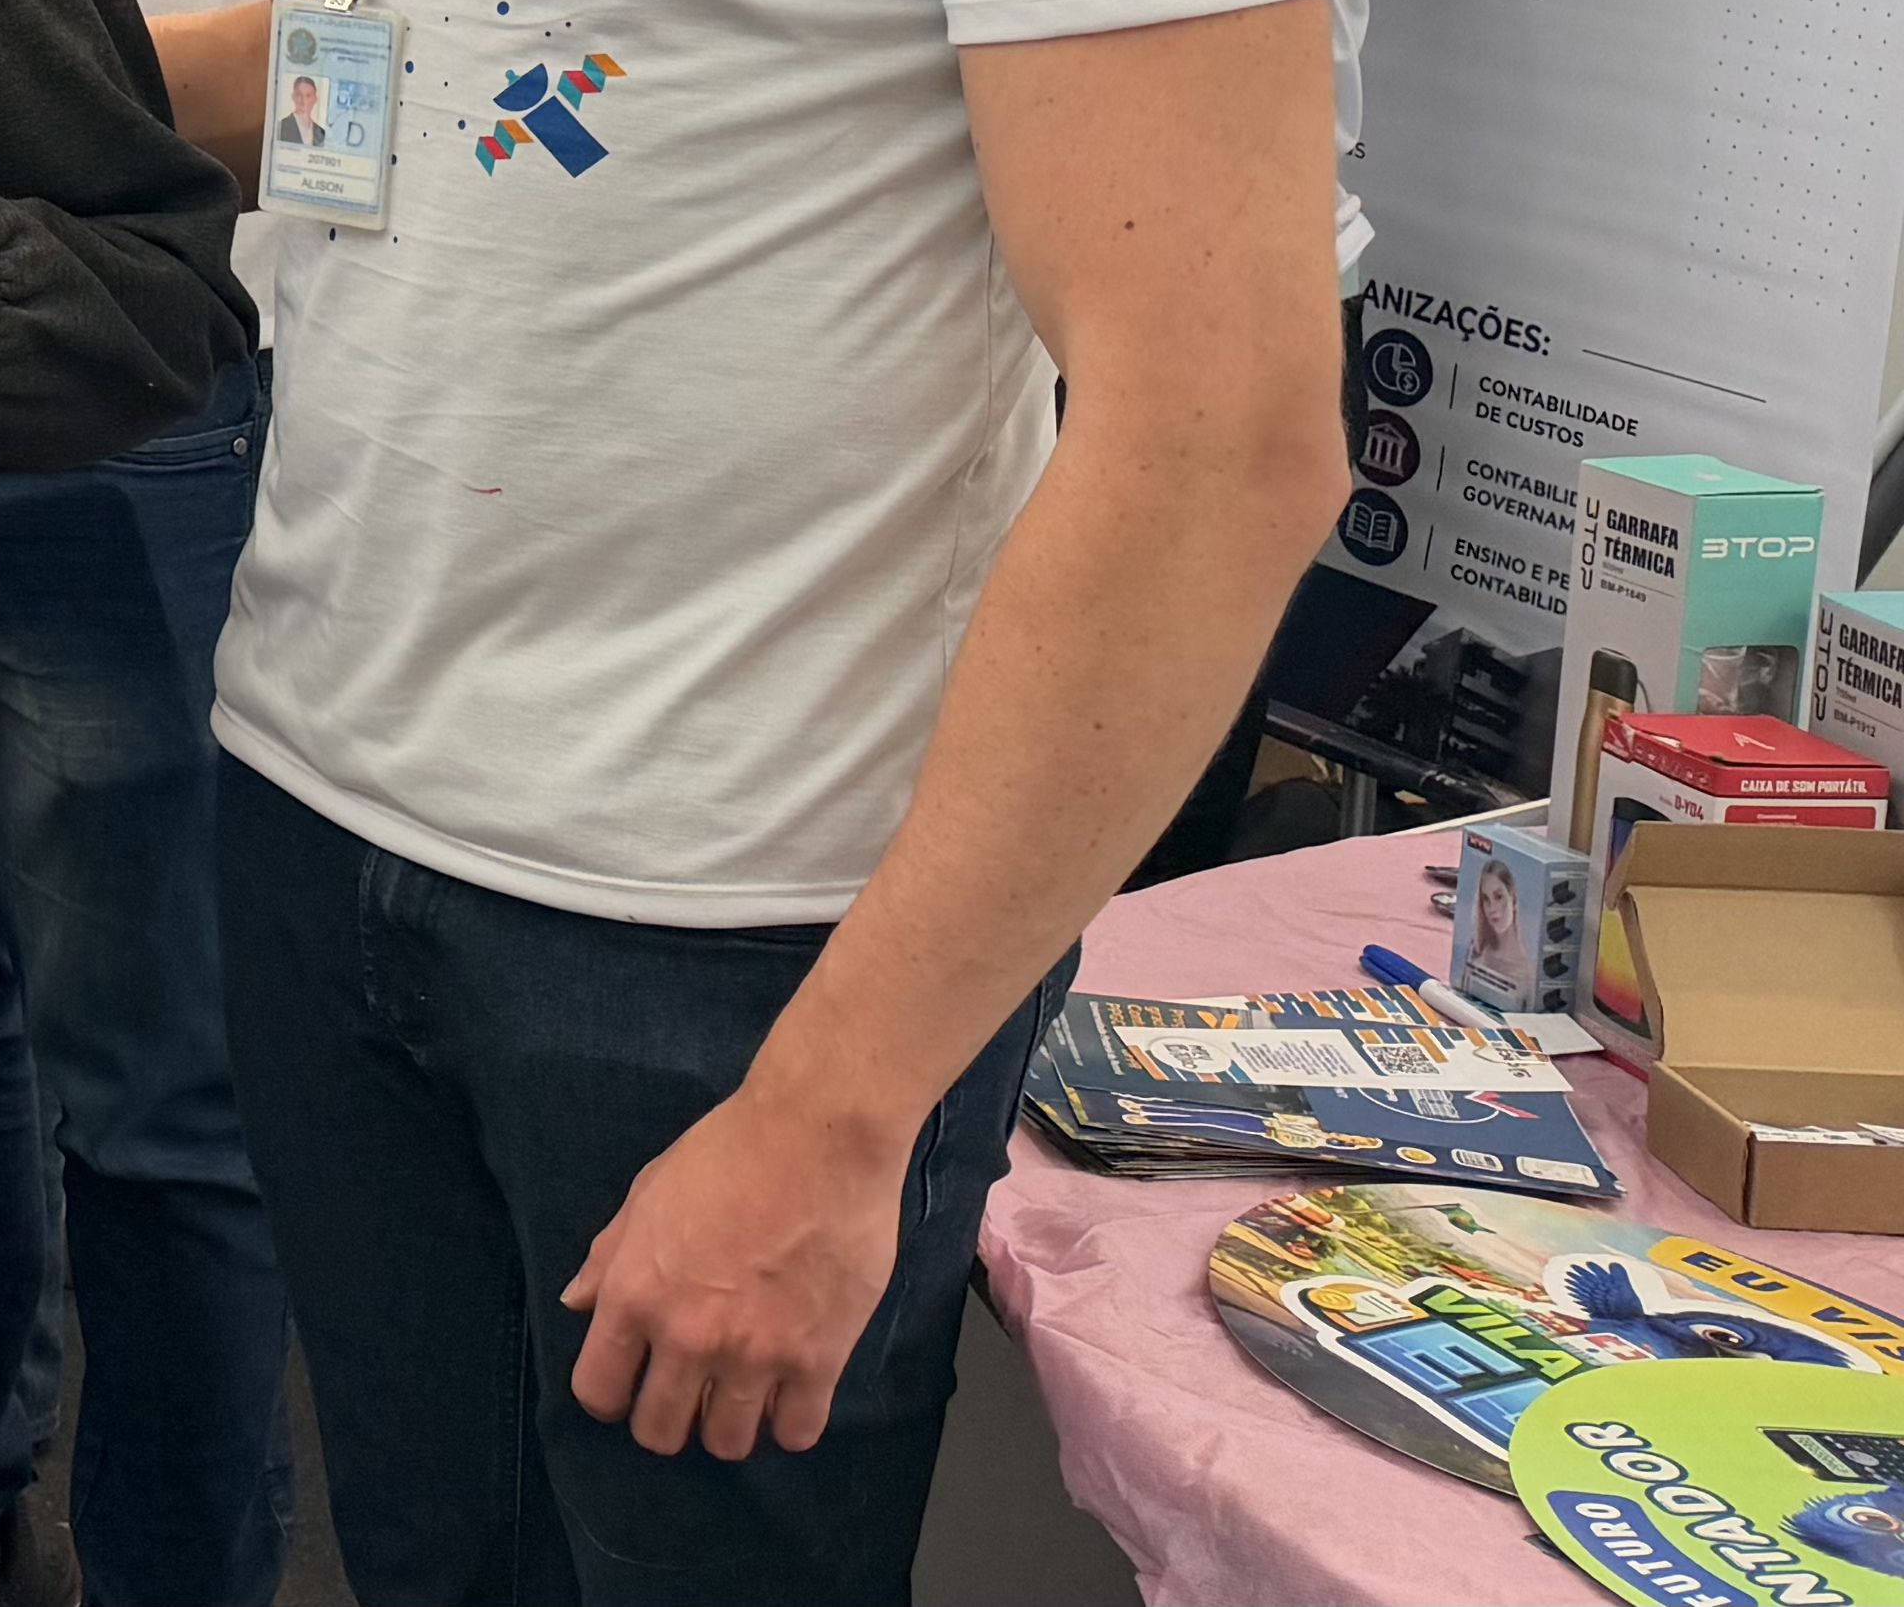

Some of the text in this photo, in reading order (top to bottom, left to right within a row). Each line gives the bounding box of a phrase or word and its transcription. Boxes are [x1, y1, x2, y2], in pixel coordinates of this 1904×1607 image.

[300, 176, 344, 194] ALISON
[1361, 279, 1552, 357] ANIZAÇÕES:
[1475, 403, 1586, 449] DE CUSTOS
[1478, 375, 1639, 438] CONTABILIDADE
[1466, 459, 1578, 508] CONTABILID
[1463, 485, 1575, 535] GOVERNAM
[1606, 508, 1679, 551] GARRAFA
[1454, 537, 1570, 592] ENSINO E PE
[1603, 534, 1676, 579] TÉRMICA
[1449, 563, 1567, 617] CONTABILID
[1836, 656, 1902, 709] TÉRMICA
[1740, 779, 1774, 792] CAIXA
[1776, 780, 1790, 792] DE
[1792, 780, 1816, 792] SOM
[1681, 1251, 1790, 1292] EU
[1421, 1285, 1586, 1382] VILA
[1568, 1422, 1850, 1606] NTADOR
[1574, 1502, 1732, 1607] FUTURO
